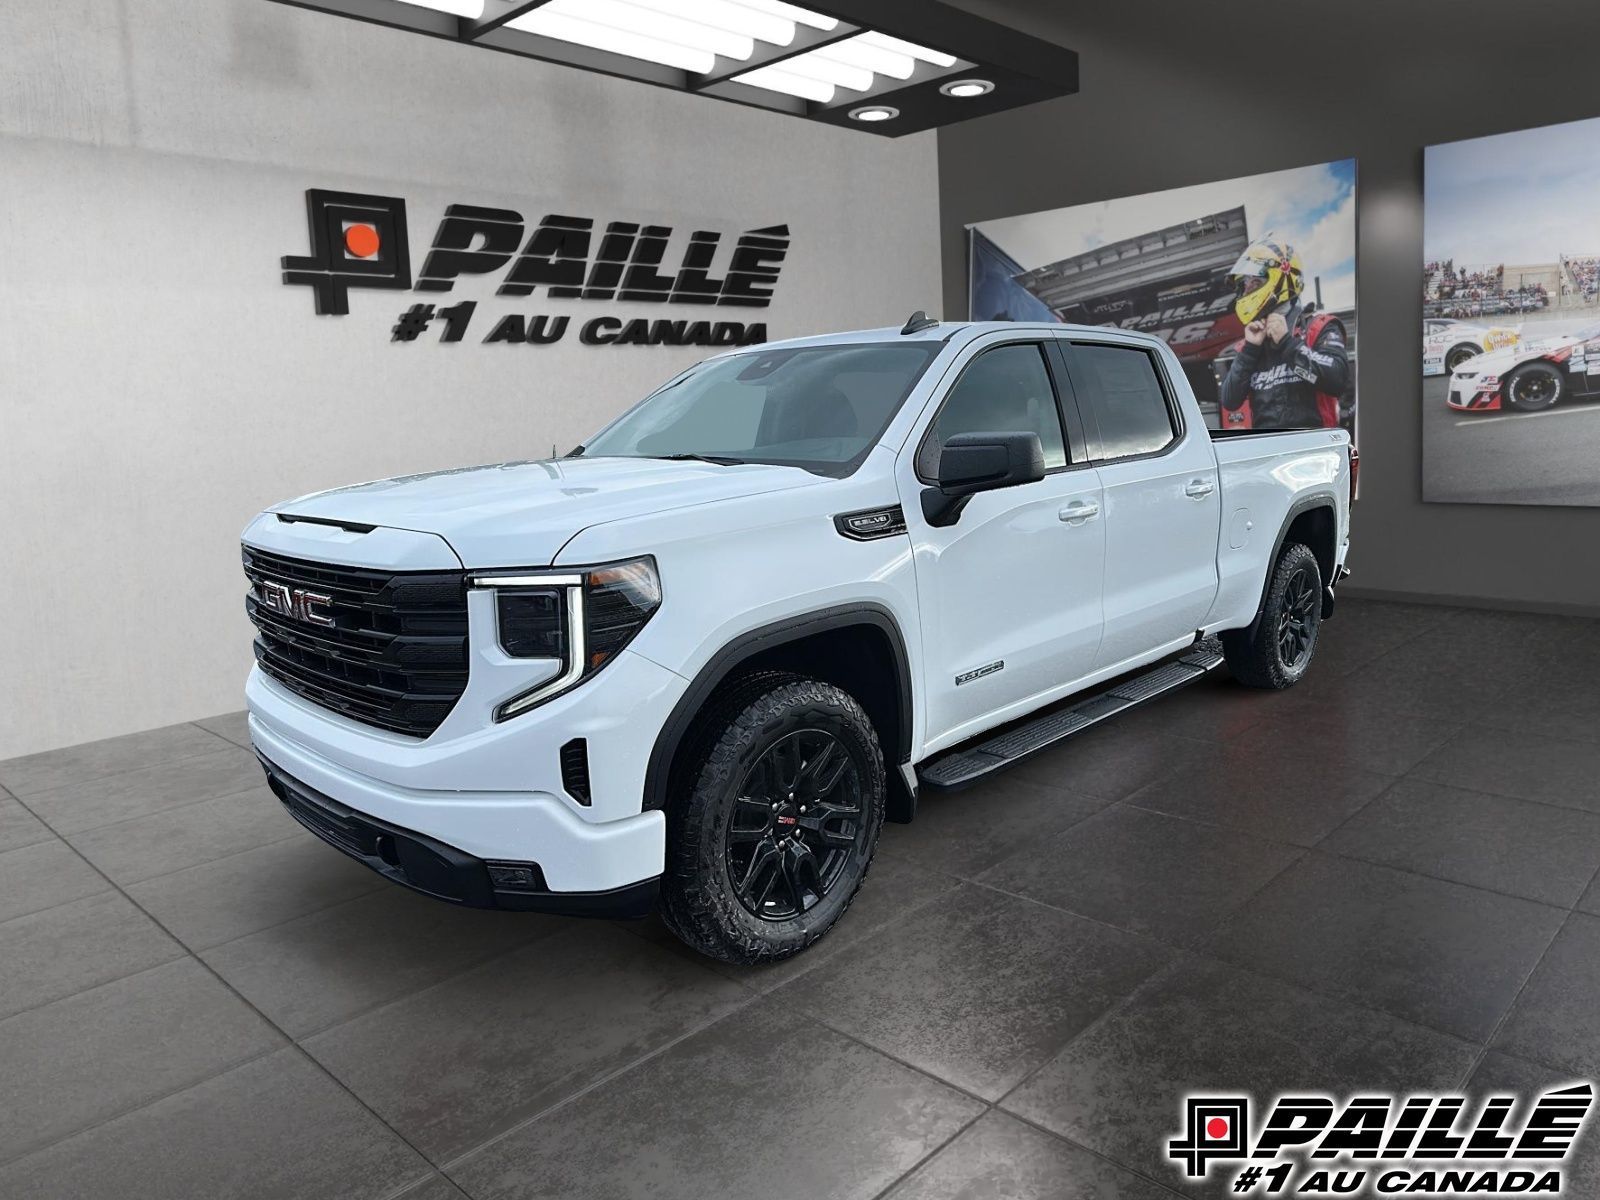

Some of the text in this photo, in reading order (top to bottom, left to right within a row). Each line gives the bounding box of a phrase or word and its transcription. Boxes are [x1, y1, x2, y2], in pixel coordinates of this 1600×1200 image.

[413, 203, 790, 307] PAILLÉ
[391, 301, 768, 346] #1 AU CANADA
[262, 580, 337, 629] GMC
